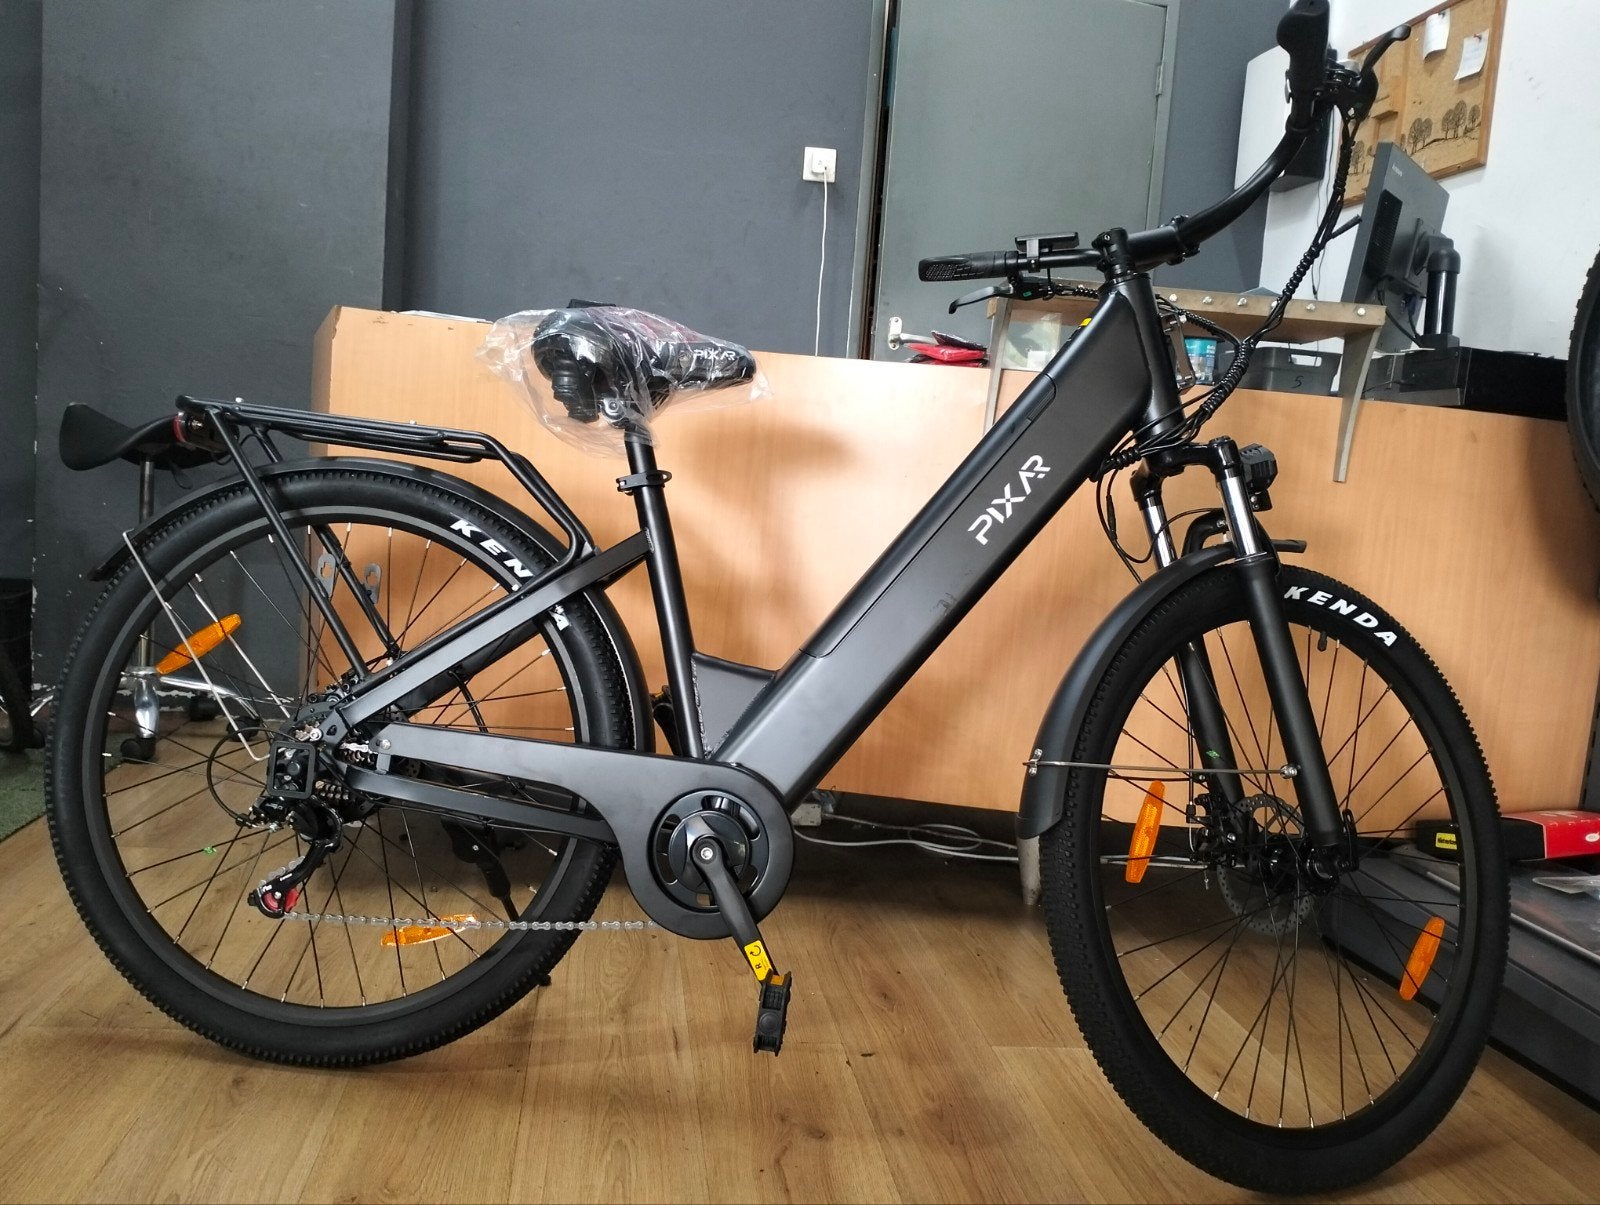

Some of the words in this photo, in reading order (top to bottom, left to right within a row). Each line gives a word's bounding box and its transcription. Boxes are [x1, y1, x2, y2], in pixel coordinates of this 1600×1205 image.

[692, 348, 736, 361] PIXAR
[967, 455, 1051, 546] PIXAR
[450, 519, 570, 631] KENA
[1283, 586, 1398, 647] KENDA
